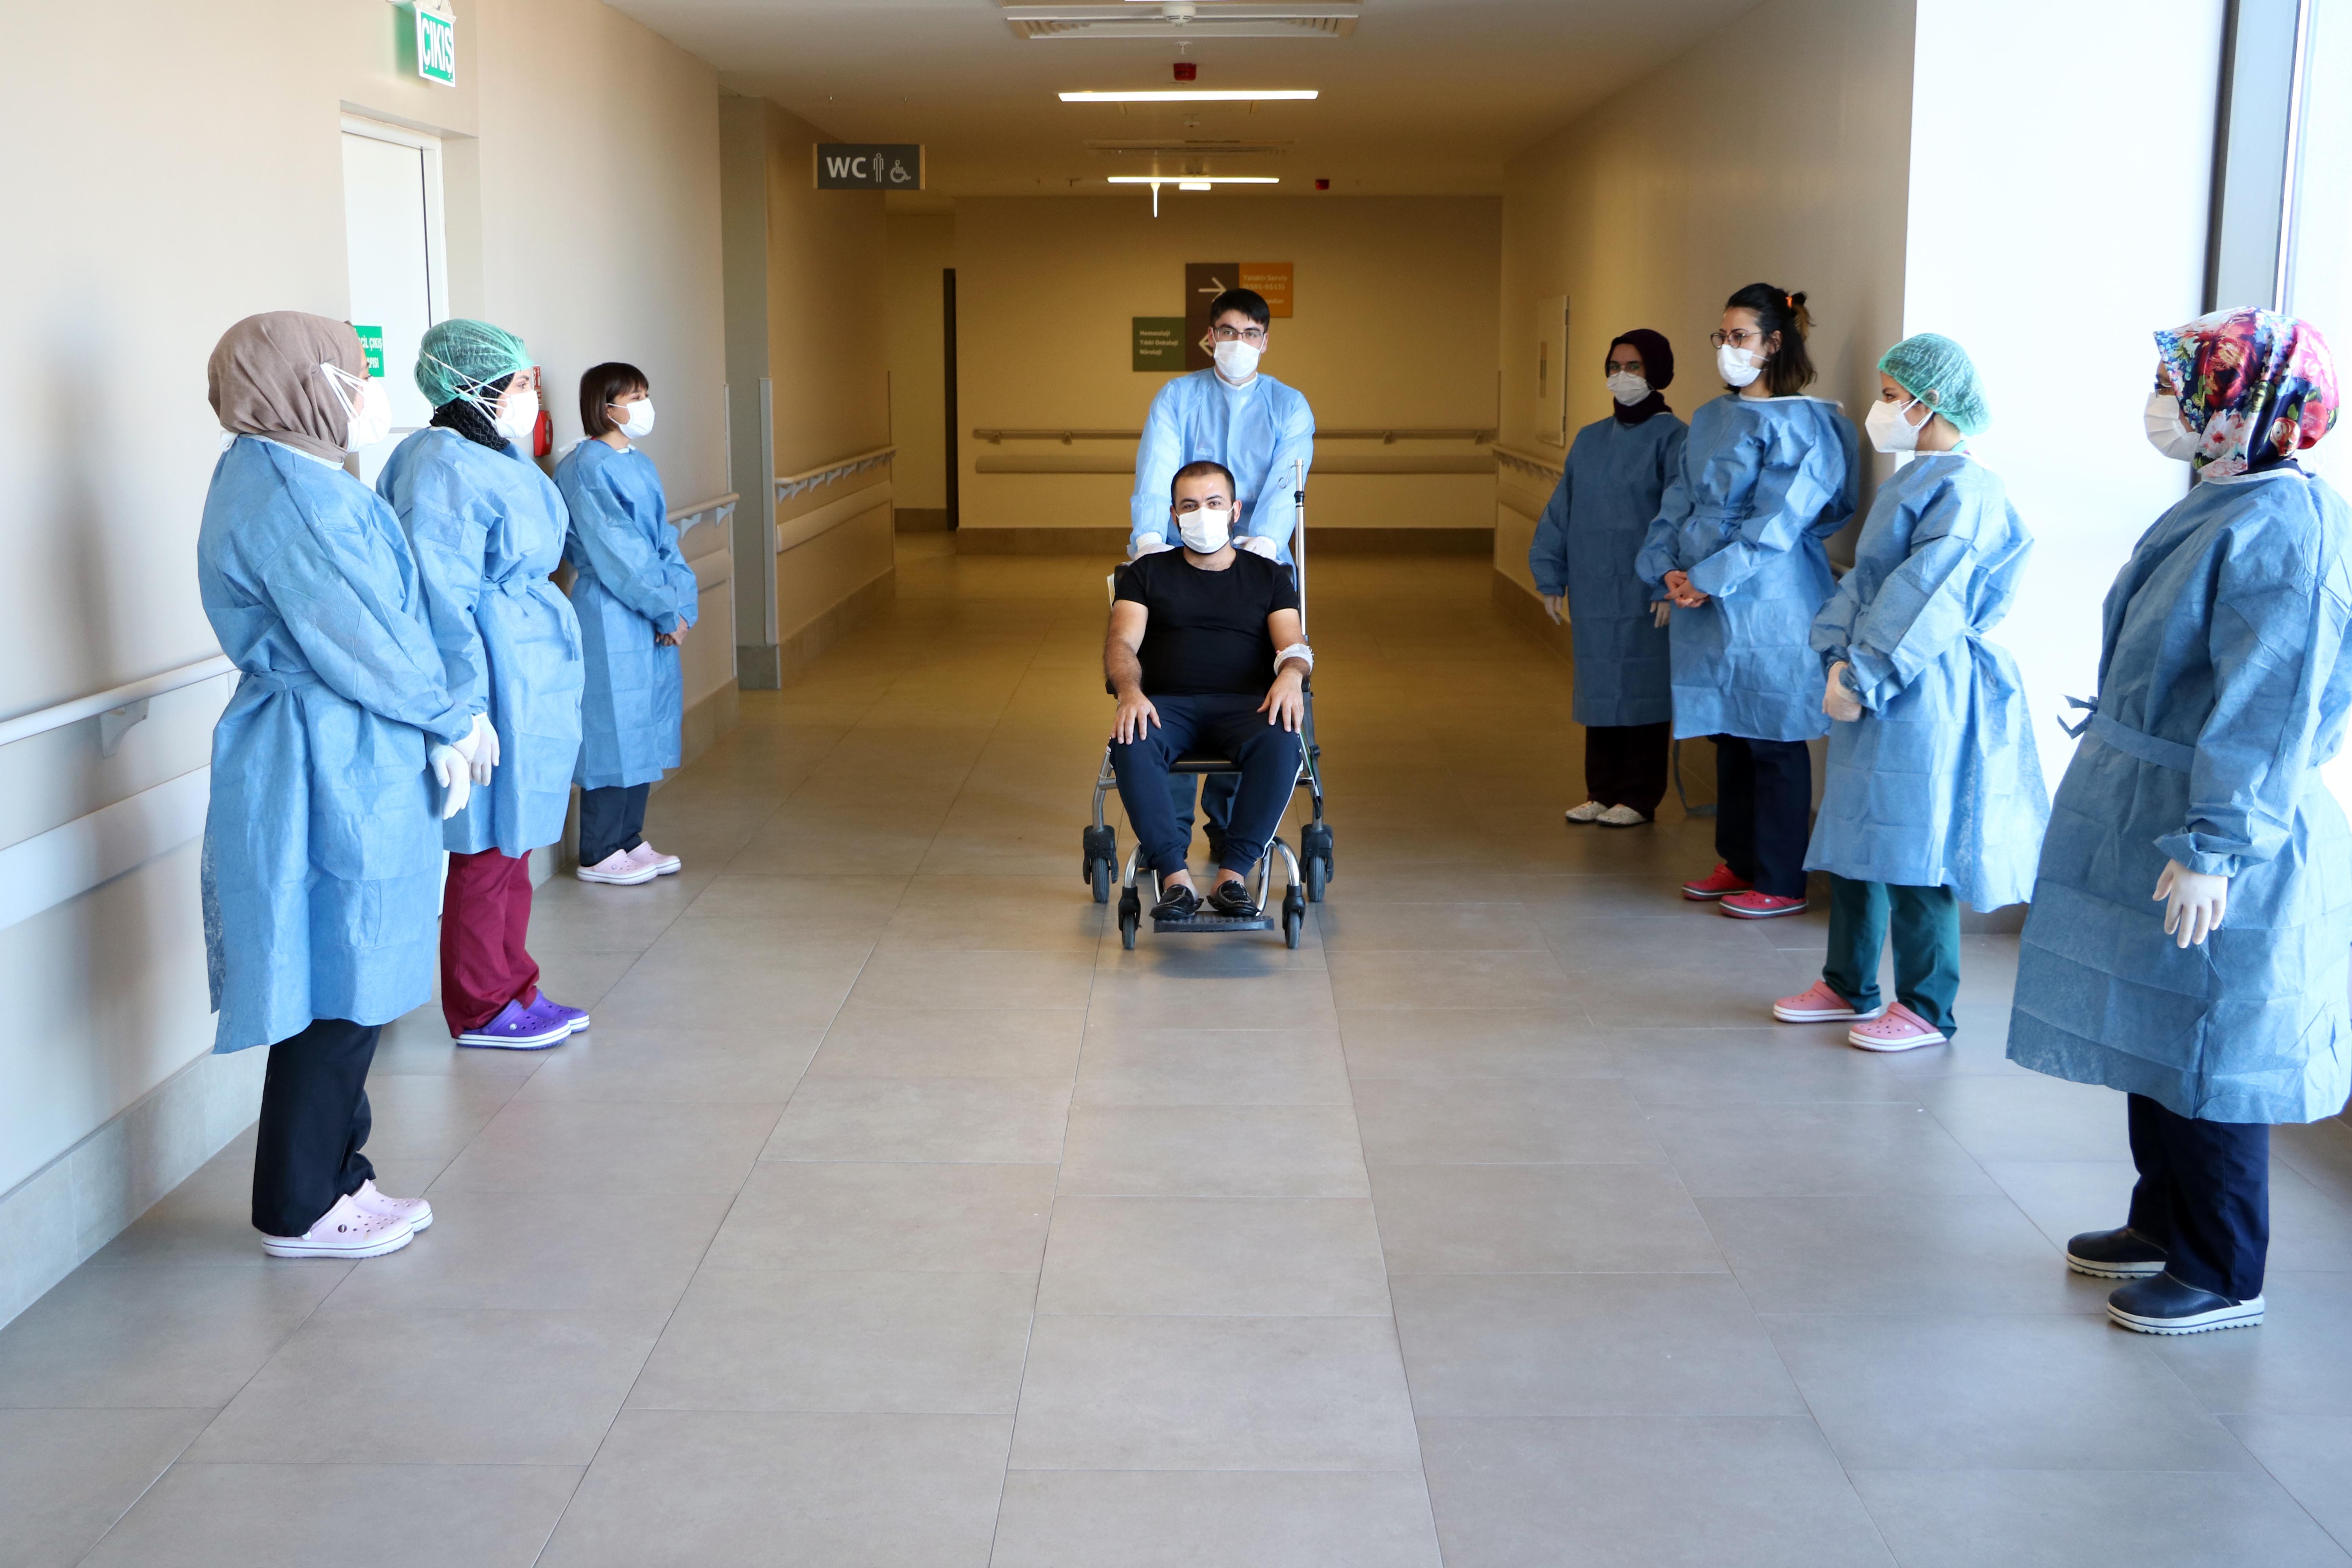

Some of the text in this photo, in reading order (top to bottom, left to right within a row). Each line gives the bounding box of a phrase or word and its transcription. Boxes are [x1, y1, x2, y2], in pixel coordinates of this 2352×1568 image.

[422, 17, 453, 78] ÇIKIŞ
[826, 157, 867, 178] WC
[369, 337, 382, 352] ÇIKIŞ
[367, 357, 379, 368] PISI
